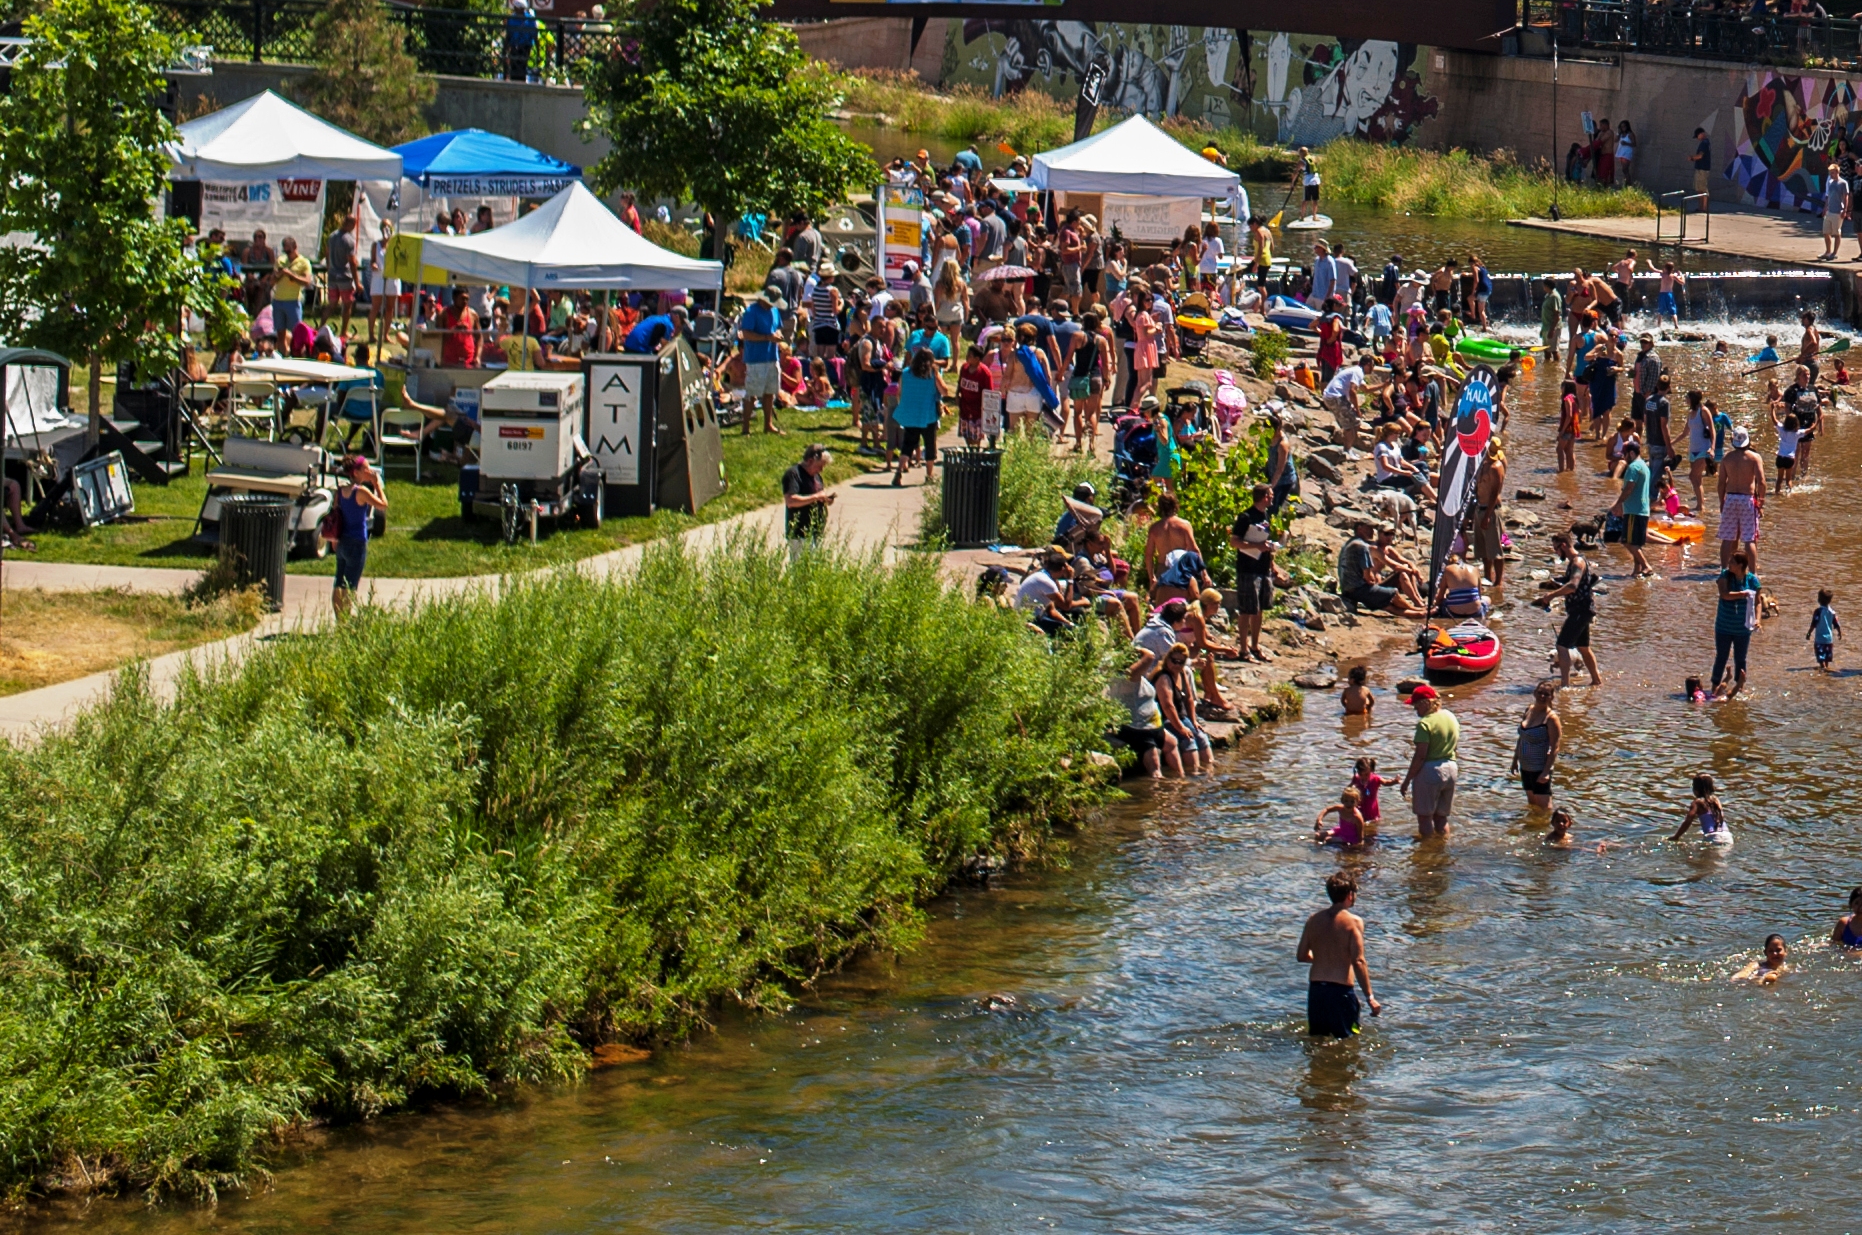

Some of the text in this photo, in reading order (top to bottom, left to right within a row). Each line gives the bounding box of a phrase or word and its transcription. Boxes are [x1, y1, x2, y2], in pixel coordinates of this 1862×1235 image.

[238, 183, 270, 202] 4 MS
[433, 179, 480, 194] PRETZELS
[488, 179, 536, 194] STRUDELS
[1466, 388, 1487, 403] HALA
[596, 373, 632, 455] ATM
[507, 441, 533, 451] 60197
